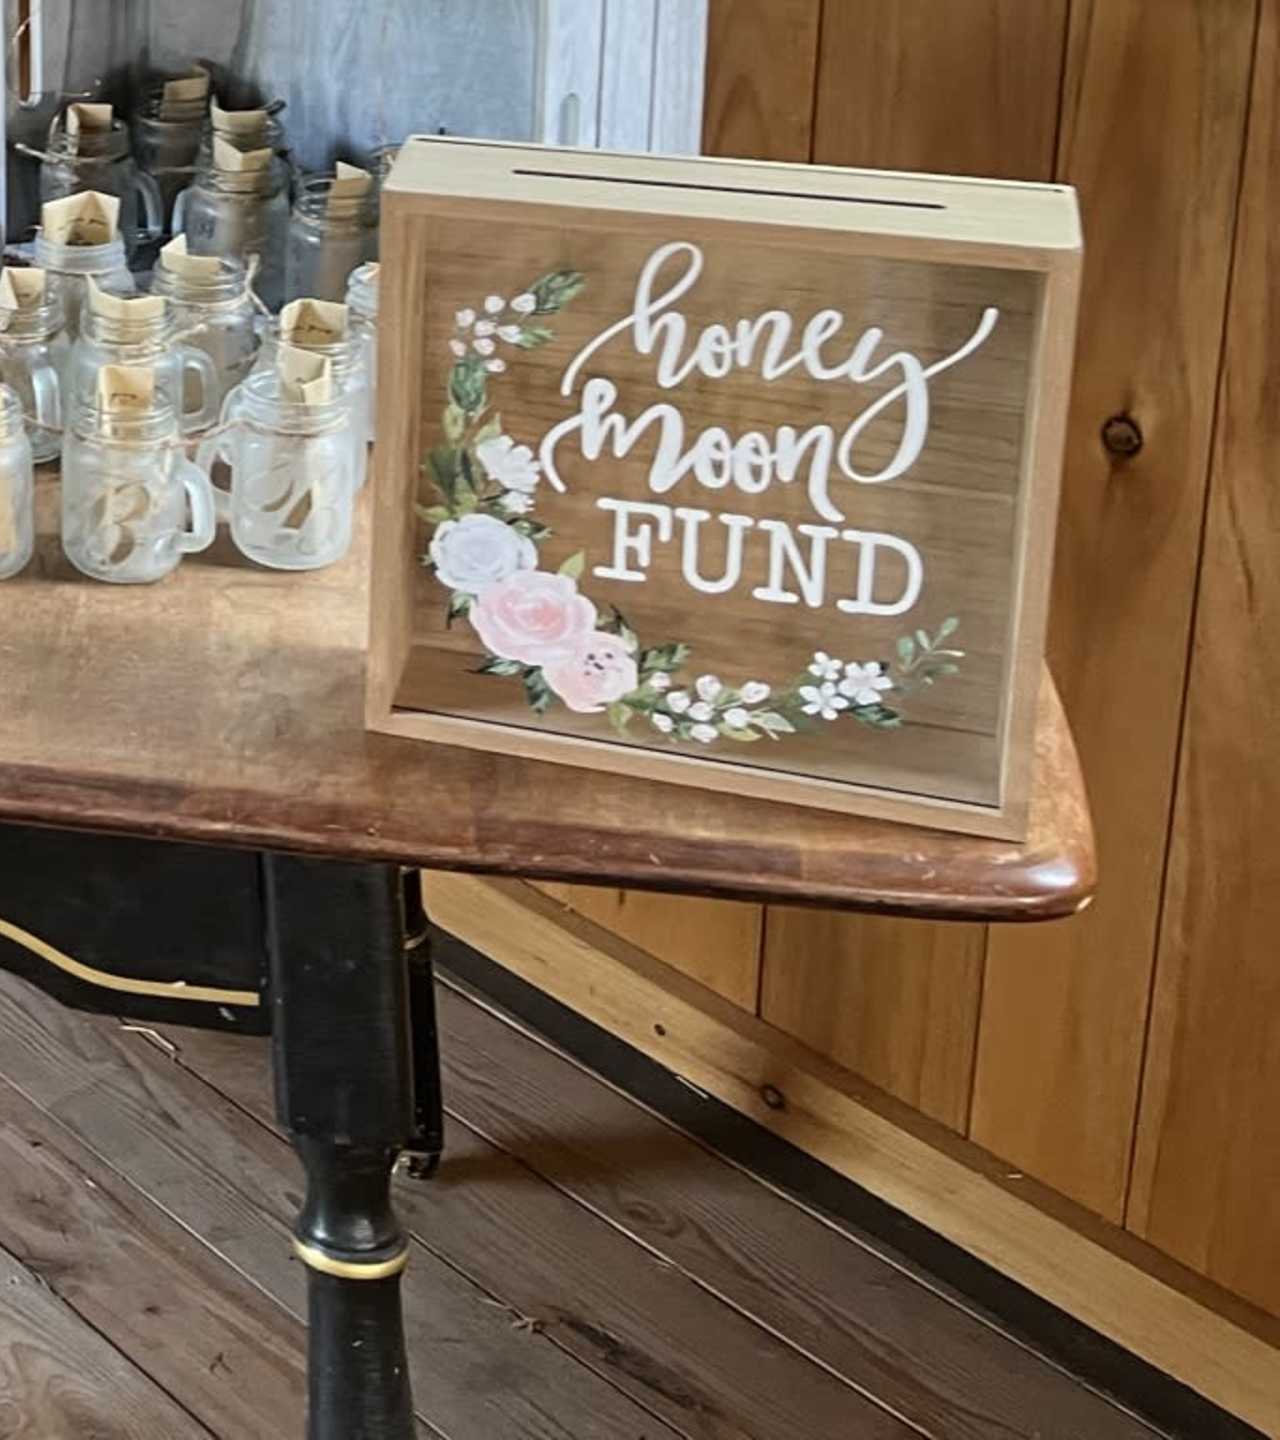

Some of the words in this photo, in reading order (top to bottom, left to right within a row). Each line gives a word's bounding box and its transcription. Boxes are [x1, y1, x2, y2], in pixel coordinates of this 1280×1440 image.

[561, 240, 999, 483] honey
[540, 377, 846, 521] moon
[592, 497, 924, 616] FUND
